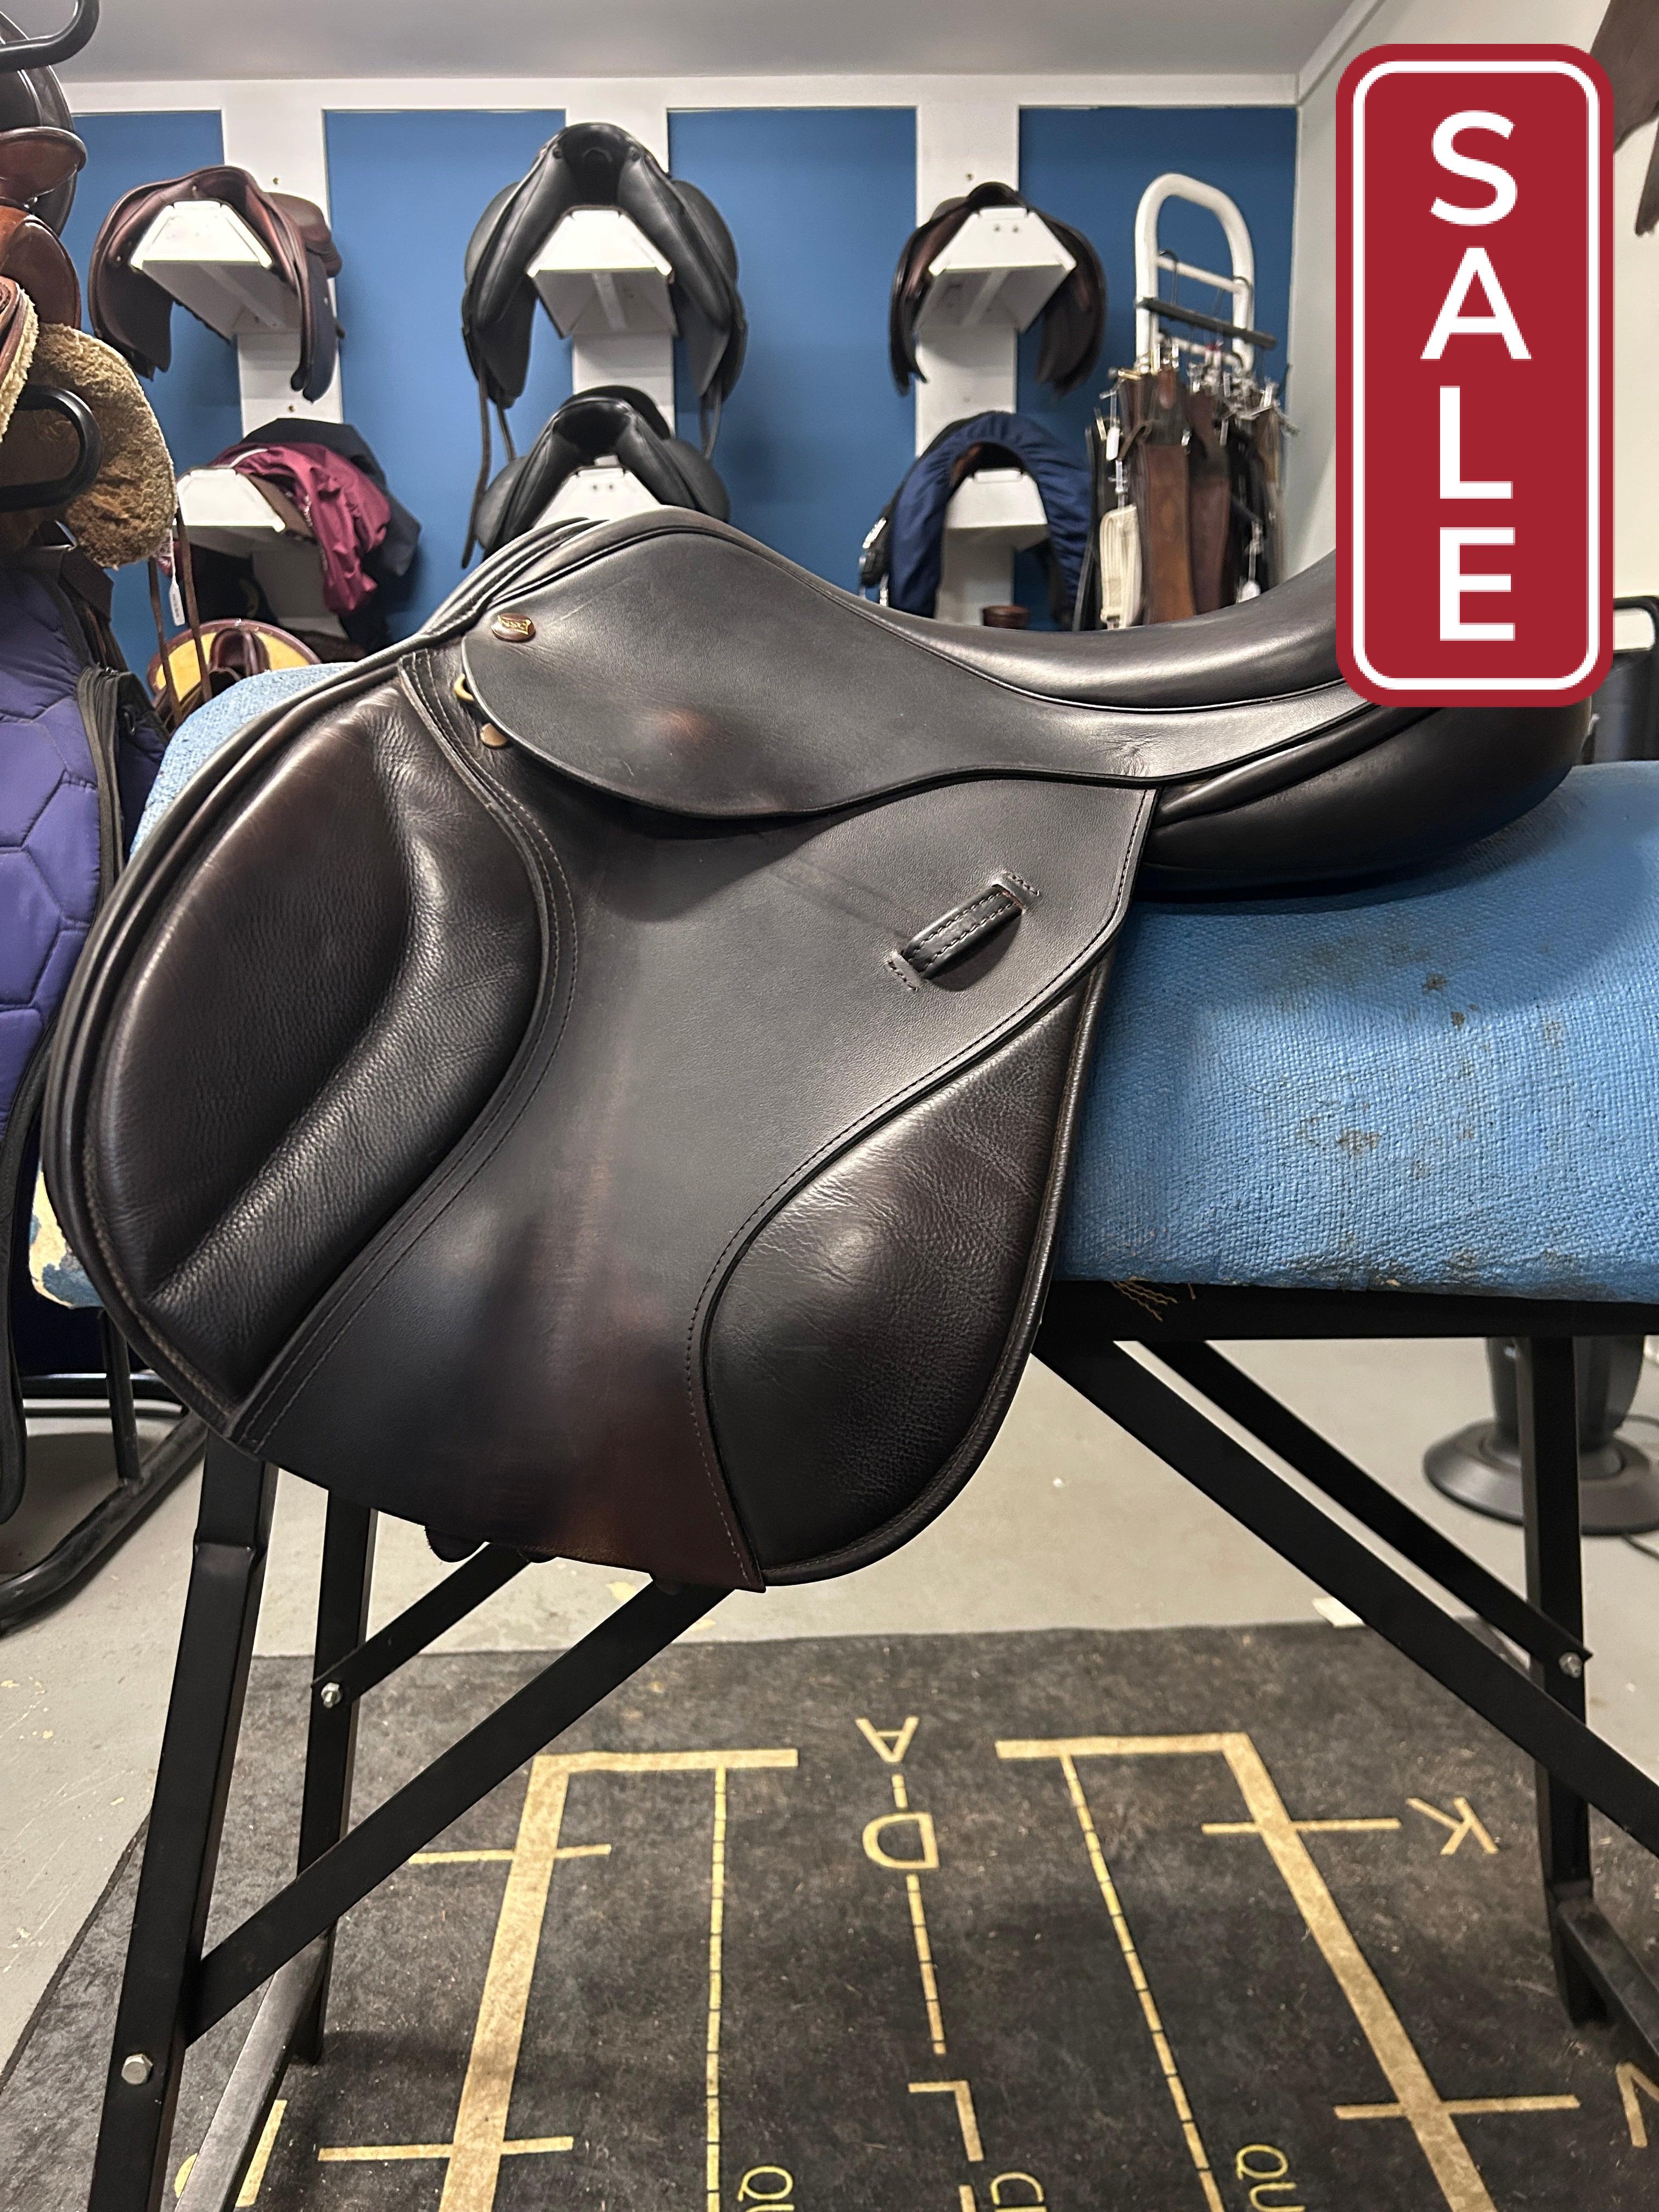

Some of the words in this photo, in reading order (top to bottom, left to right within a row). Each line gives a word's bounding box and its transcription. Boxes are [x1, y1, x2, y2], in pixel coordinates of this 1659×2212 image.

[855, 1715, 919, 1763] A
[862, 1812, 939, 1868] D
[1406, 1796, 1499, 1855] K
[908, 2080, 984, 2162] L
[990, 2171, 1047, 2212] C
